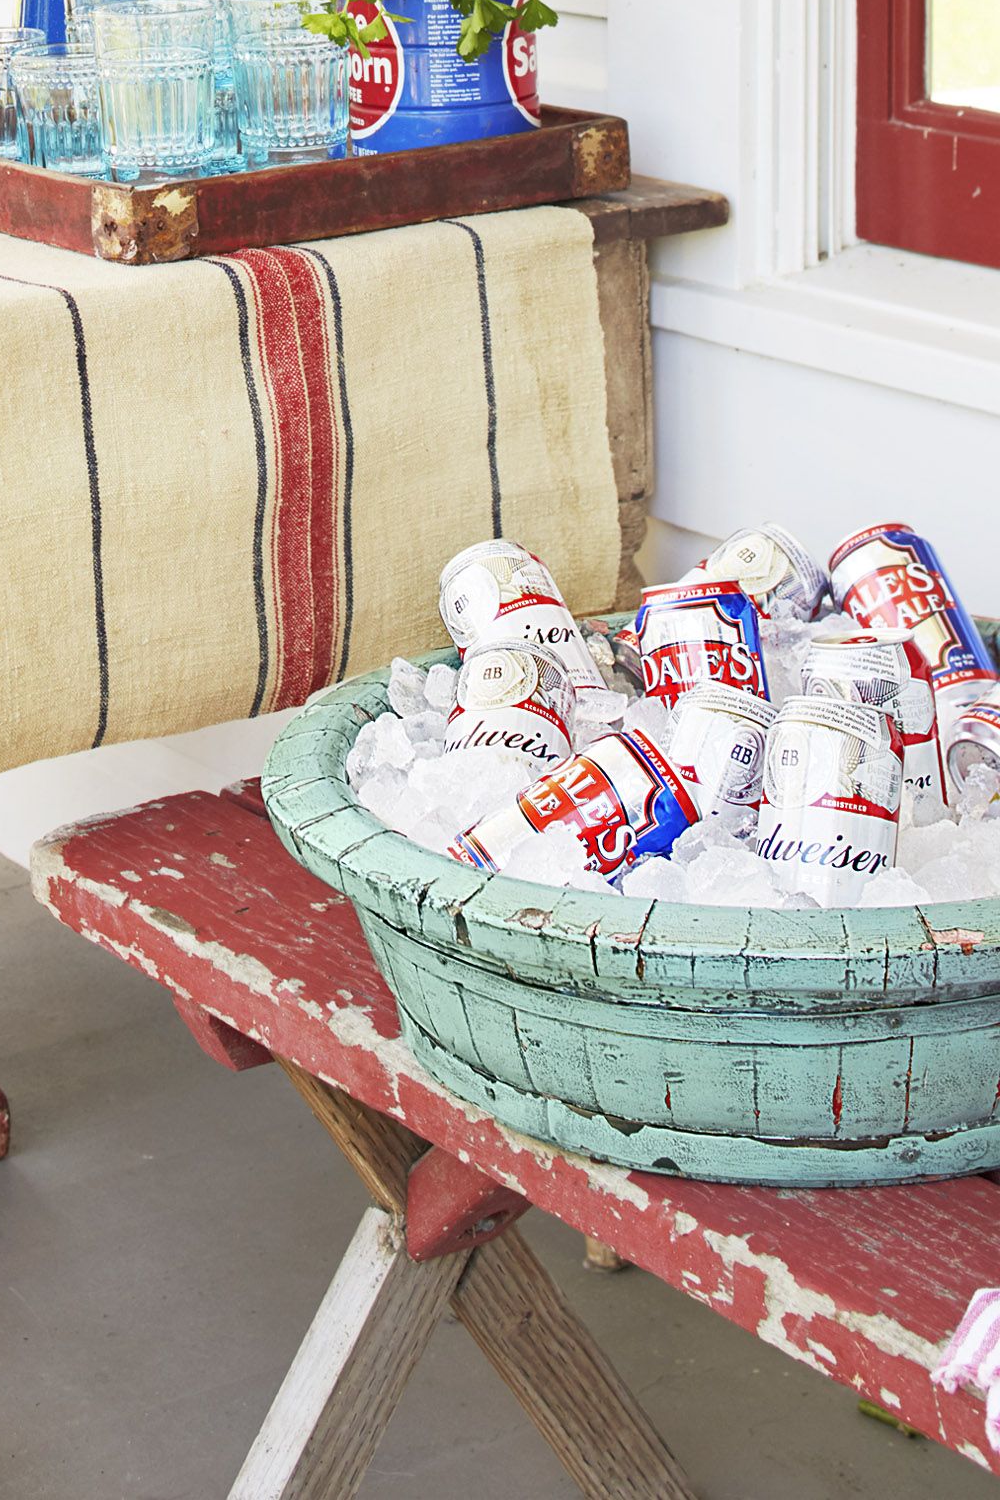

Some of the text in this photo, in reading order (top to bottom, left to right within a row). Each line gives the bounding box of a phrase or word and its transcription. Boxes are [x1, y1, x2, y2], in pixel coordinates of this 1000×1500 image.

[847, 562, 935, 618] ALE'S
[483, 667, 502, 681] AB
[640, 643, 755, 694] DALE'S
[524, 702, 559, 726] REGISTERED
[730, 743, 753, 765] AB
[782, 749, 799, 767] AB
[553, 763, 637, 861] ALE'S
[821, 798, 867, 813] REGISTERED
[757, 823, 888, 875] dweiser
